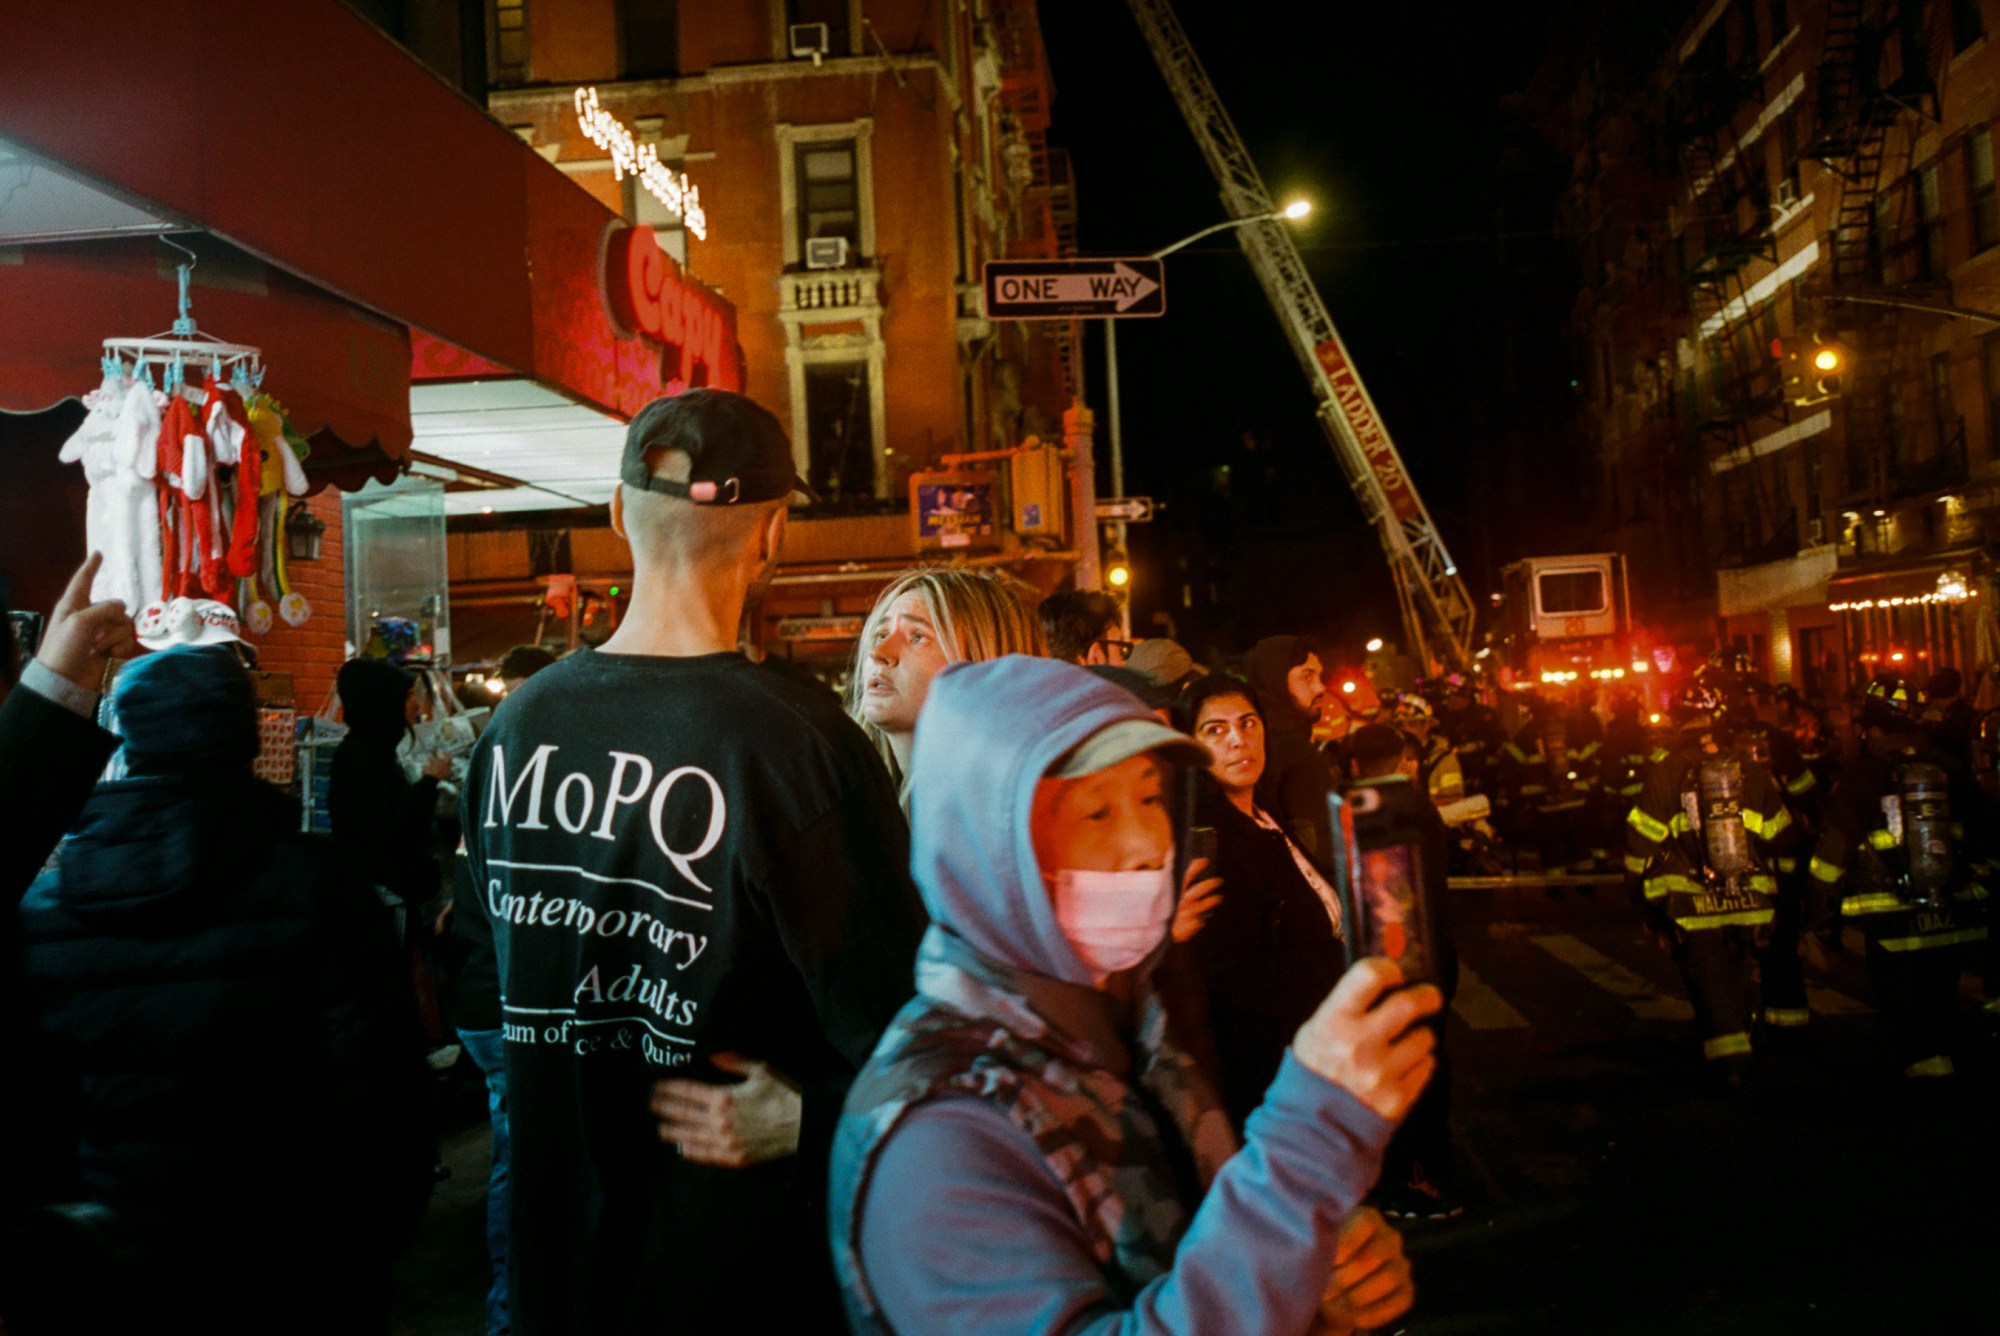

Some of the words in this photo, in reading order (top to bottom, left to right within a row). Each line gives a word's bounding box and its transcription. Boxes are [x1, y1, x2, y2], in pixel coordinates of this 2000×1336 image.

[1002, 278, 1058, 300] ONE
[1089, 276, 1141, 298] WAY
[1330, 365, 1390, 459] LADDER
[1374, 458, 1404, 491] 20
[483, 743, 727, 893] MoPQ
[573, 963, 698, 1026] Adults
[543, 1019, 574, 1044] of
